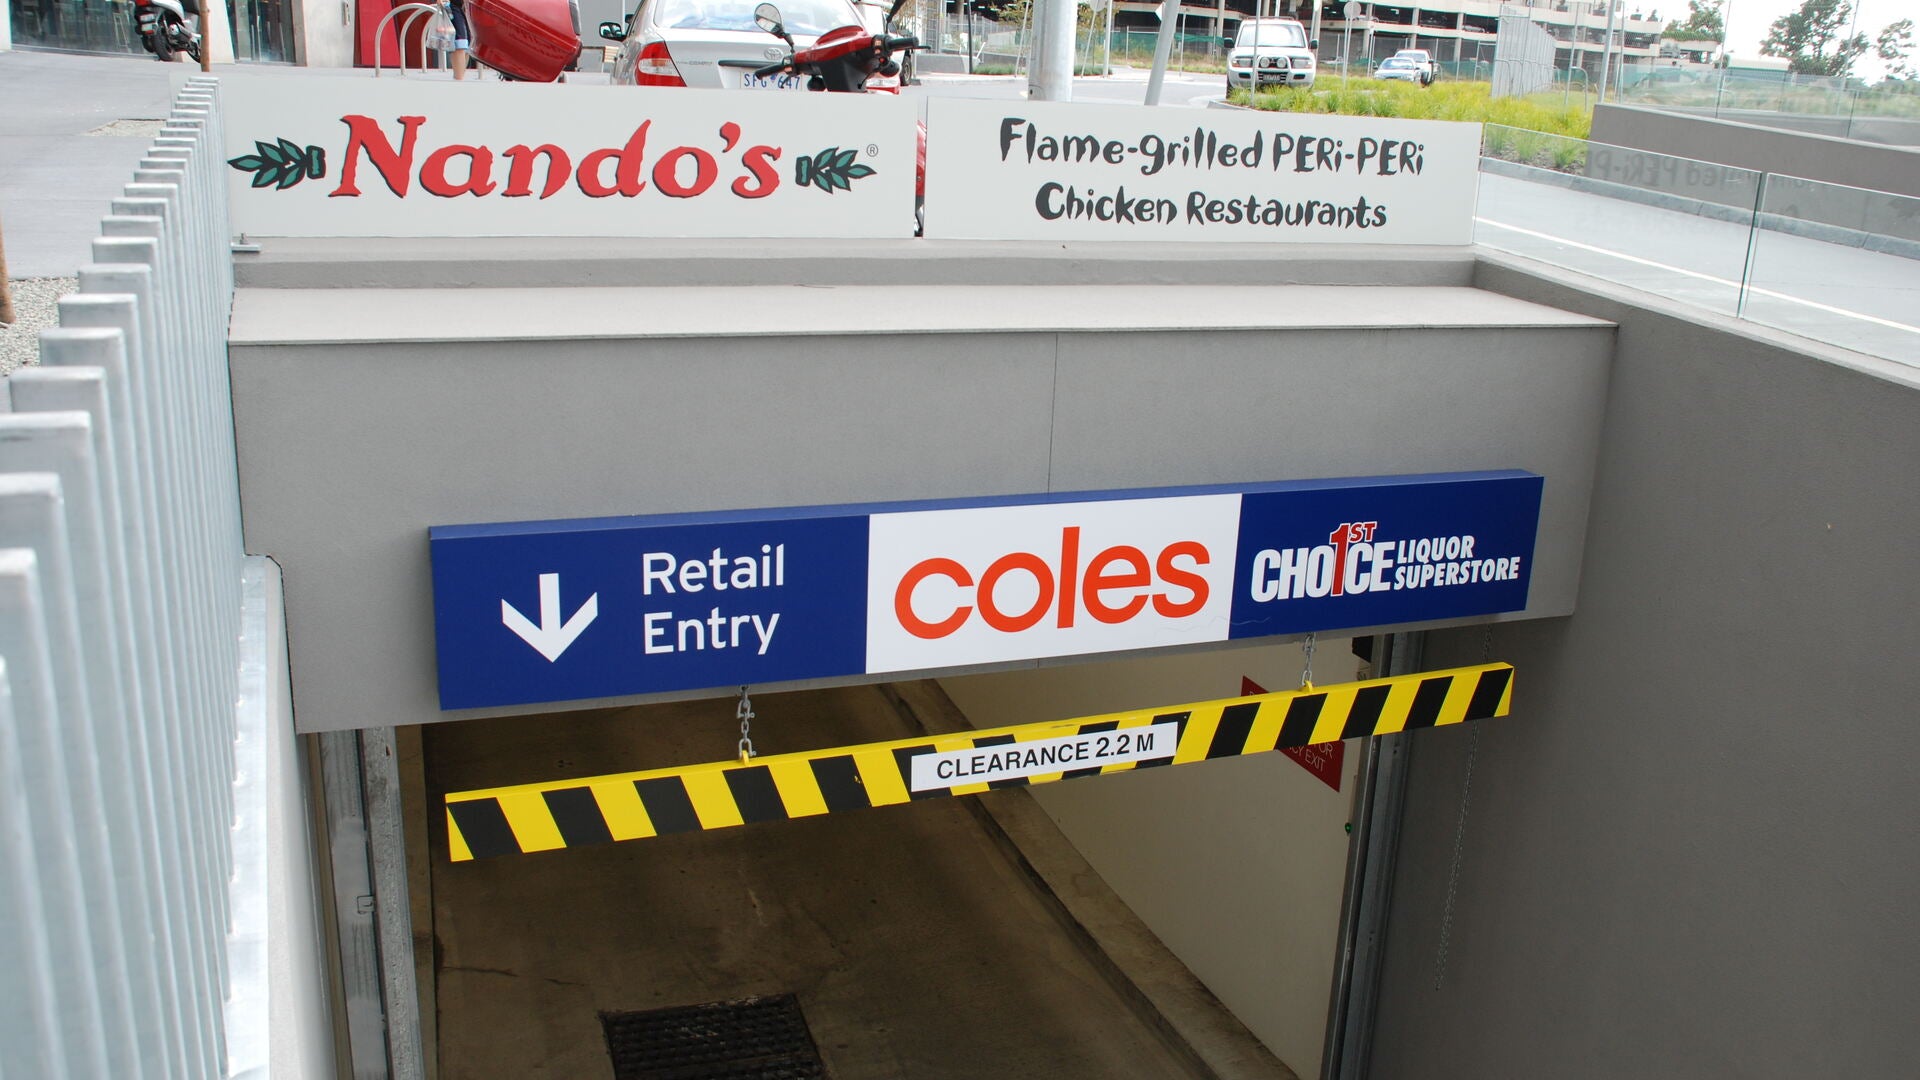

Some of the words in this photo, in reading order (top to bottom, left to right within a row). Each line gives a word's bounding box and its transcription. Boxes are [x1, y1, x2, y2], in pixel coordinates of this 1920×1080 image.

[327, 114, 782, 200] Nando's
[1000, 117, 1264, 175] Flame-grilled
[1035, 182, 1178, 225] Chicken
[1187, 191, 1387, 229] Restaurants
[643, 543, 784, 595] Retail
[1394, 556, 1521, 591] SUPERSTORE
[1397, 535, 1475, 565] LIQUOR
[894, 526, 1210, 639] coles
[644, 607, 780, 655] Entry
[936, 741, 1089, 780] CLEARANCE
[1095, 733, 1131, 759] 2.2
[1136, 733, 1155, 753] M
[1304, 748, 1326, 772] EXIT
